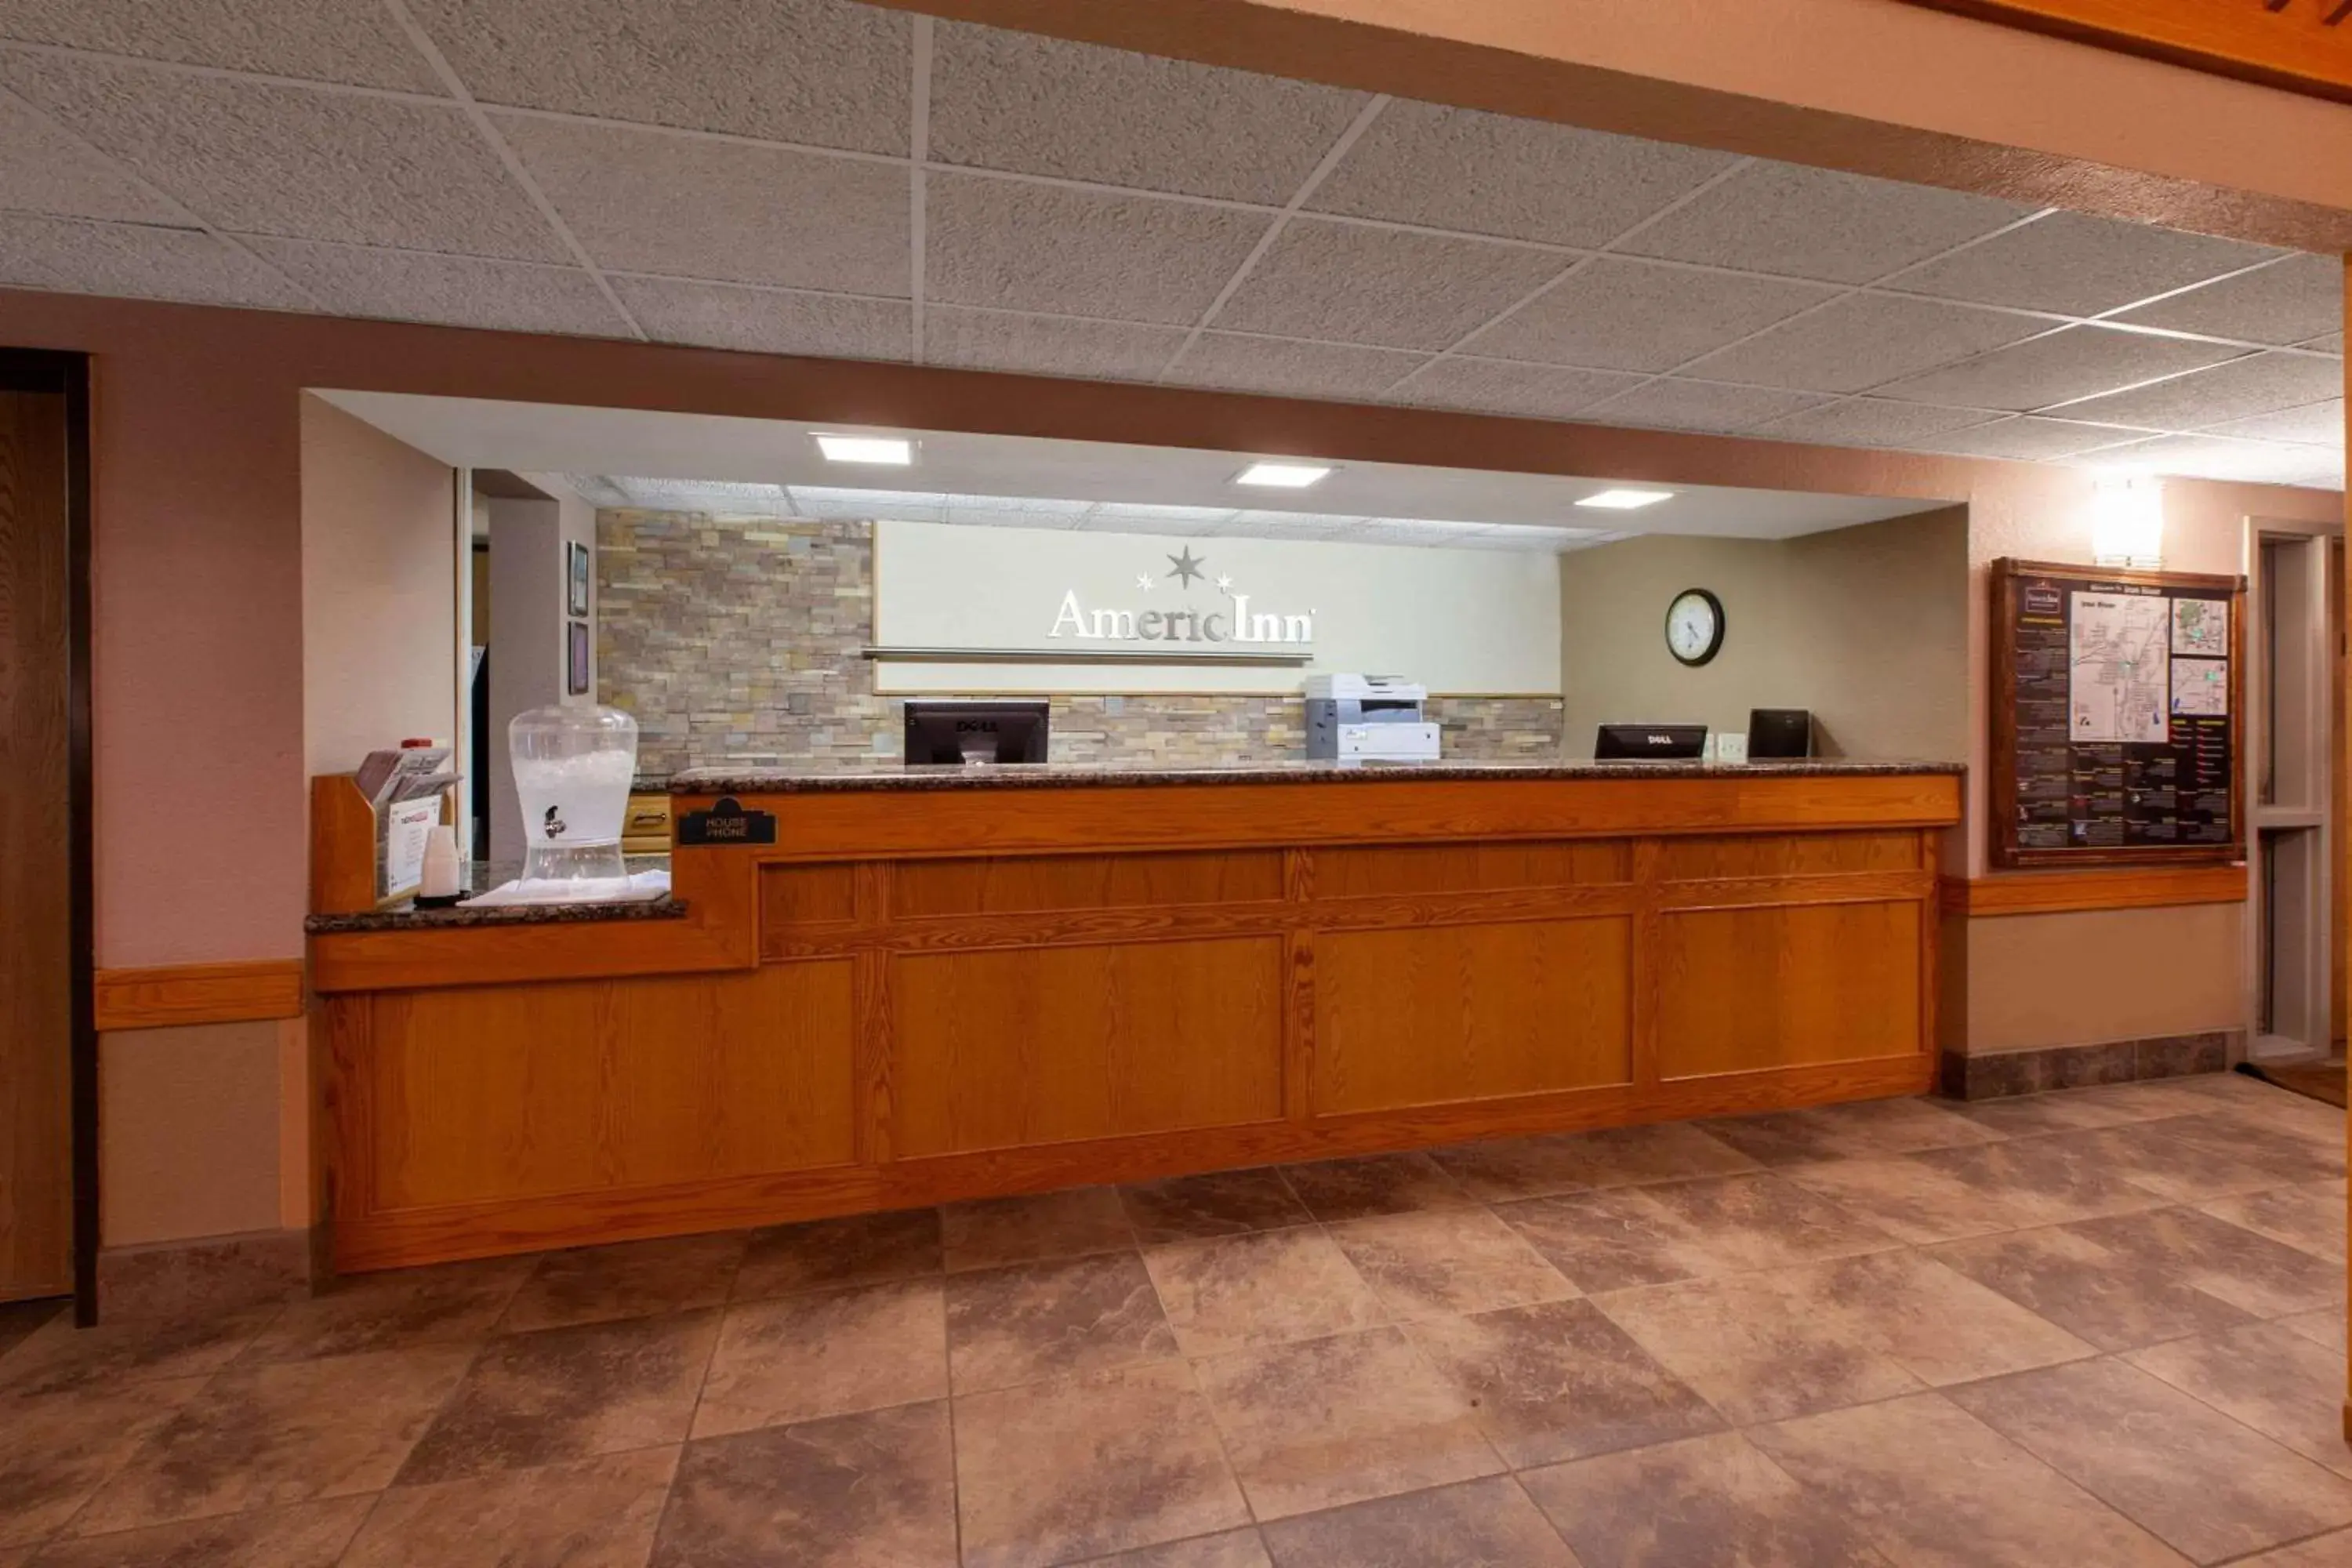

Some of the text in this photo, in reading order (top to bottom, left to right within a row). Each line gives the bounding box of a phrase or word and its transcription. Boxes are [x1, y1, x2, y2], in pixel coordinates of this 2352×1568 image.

[1046, 589, 1314, 644] AmericInn
[956, 720, 999, 732] DELL
[1647, 734, 1673, 744] DELL
[706, 818, 747, 828] HOUSE
[706, 827, 747, 838] PHONE
